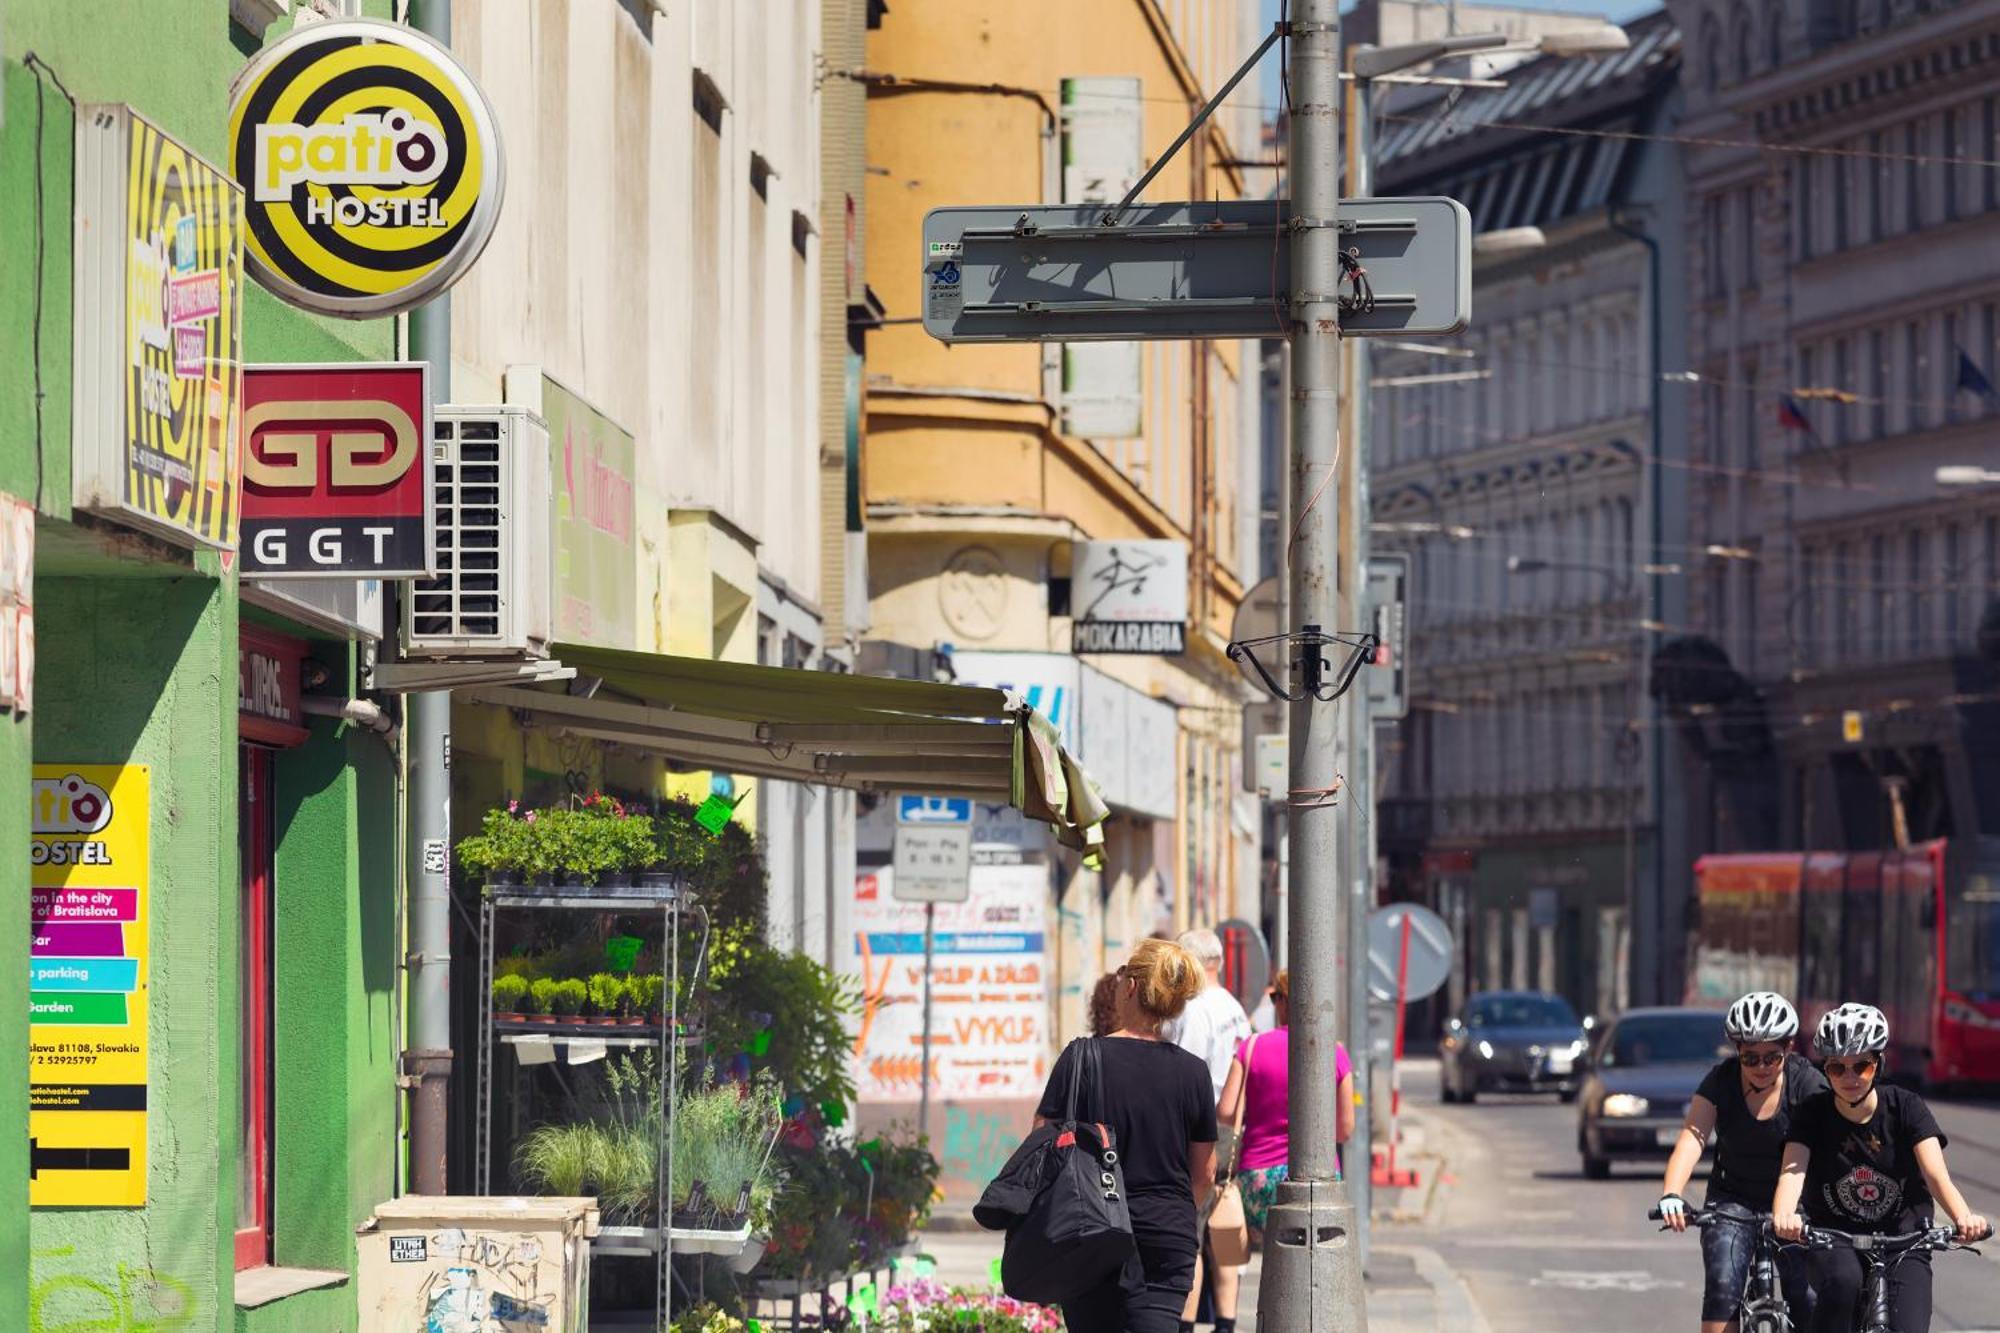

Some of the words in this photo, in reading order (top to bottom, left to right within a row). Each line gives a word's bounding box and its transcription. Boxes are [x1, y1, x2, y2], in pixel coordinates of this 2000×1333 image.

[265, 116, 437, 189] patio
[307, 197, 448, 227] HOSTEL
[1074, 622, 1184, 651] MOKARABIA
[32, 780, 103, 824] tio
[31, 841, 112, 865] OSTEL
[52, 892, 63, 904] in
[67, 892, 88, 904] the
[91, 892, 113, 906] city
[37, 905, 51, 917] of
[54, 905, 119, 917] Bratislava
[38, 966, 89, 981] parking
[58, 1043, 94, 1055] 81108,
[96, 1043, 140, 1053] Slovakia
[47, 1056, 98, 1065] 52925797
